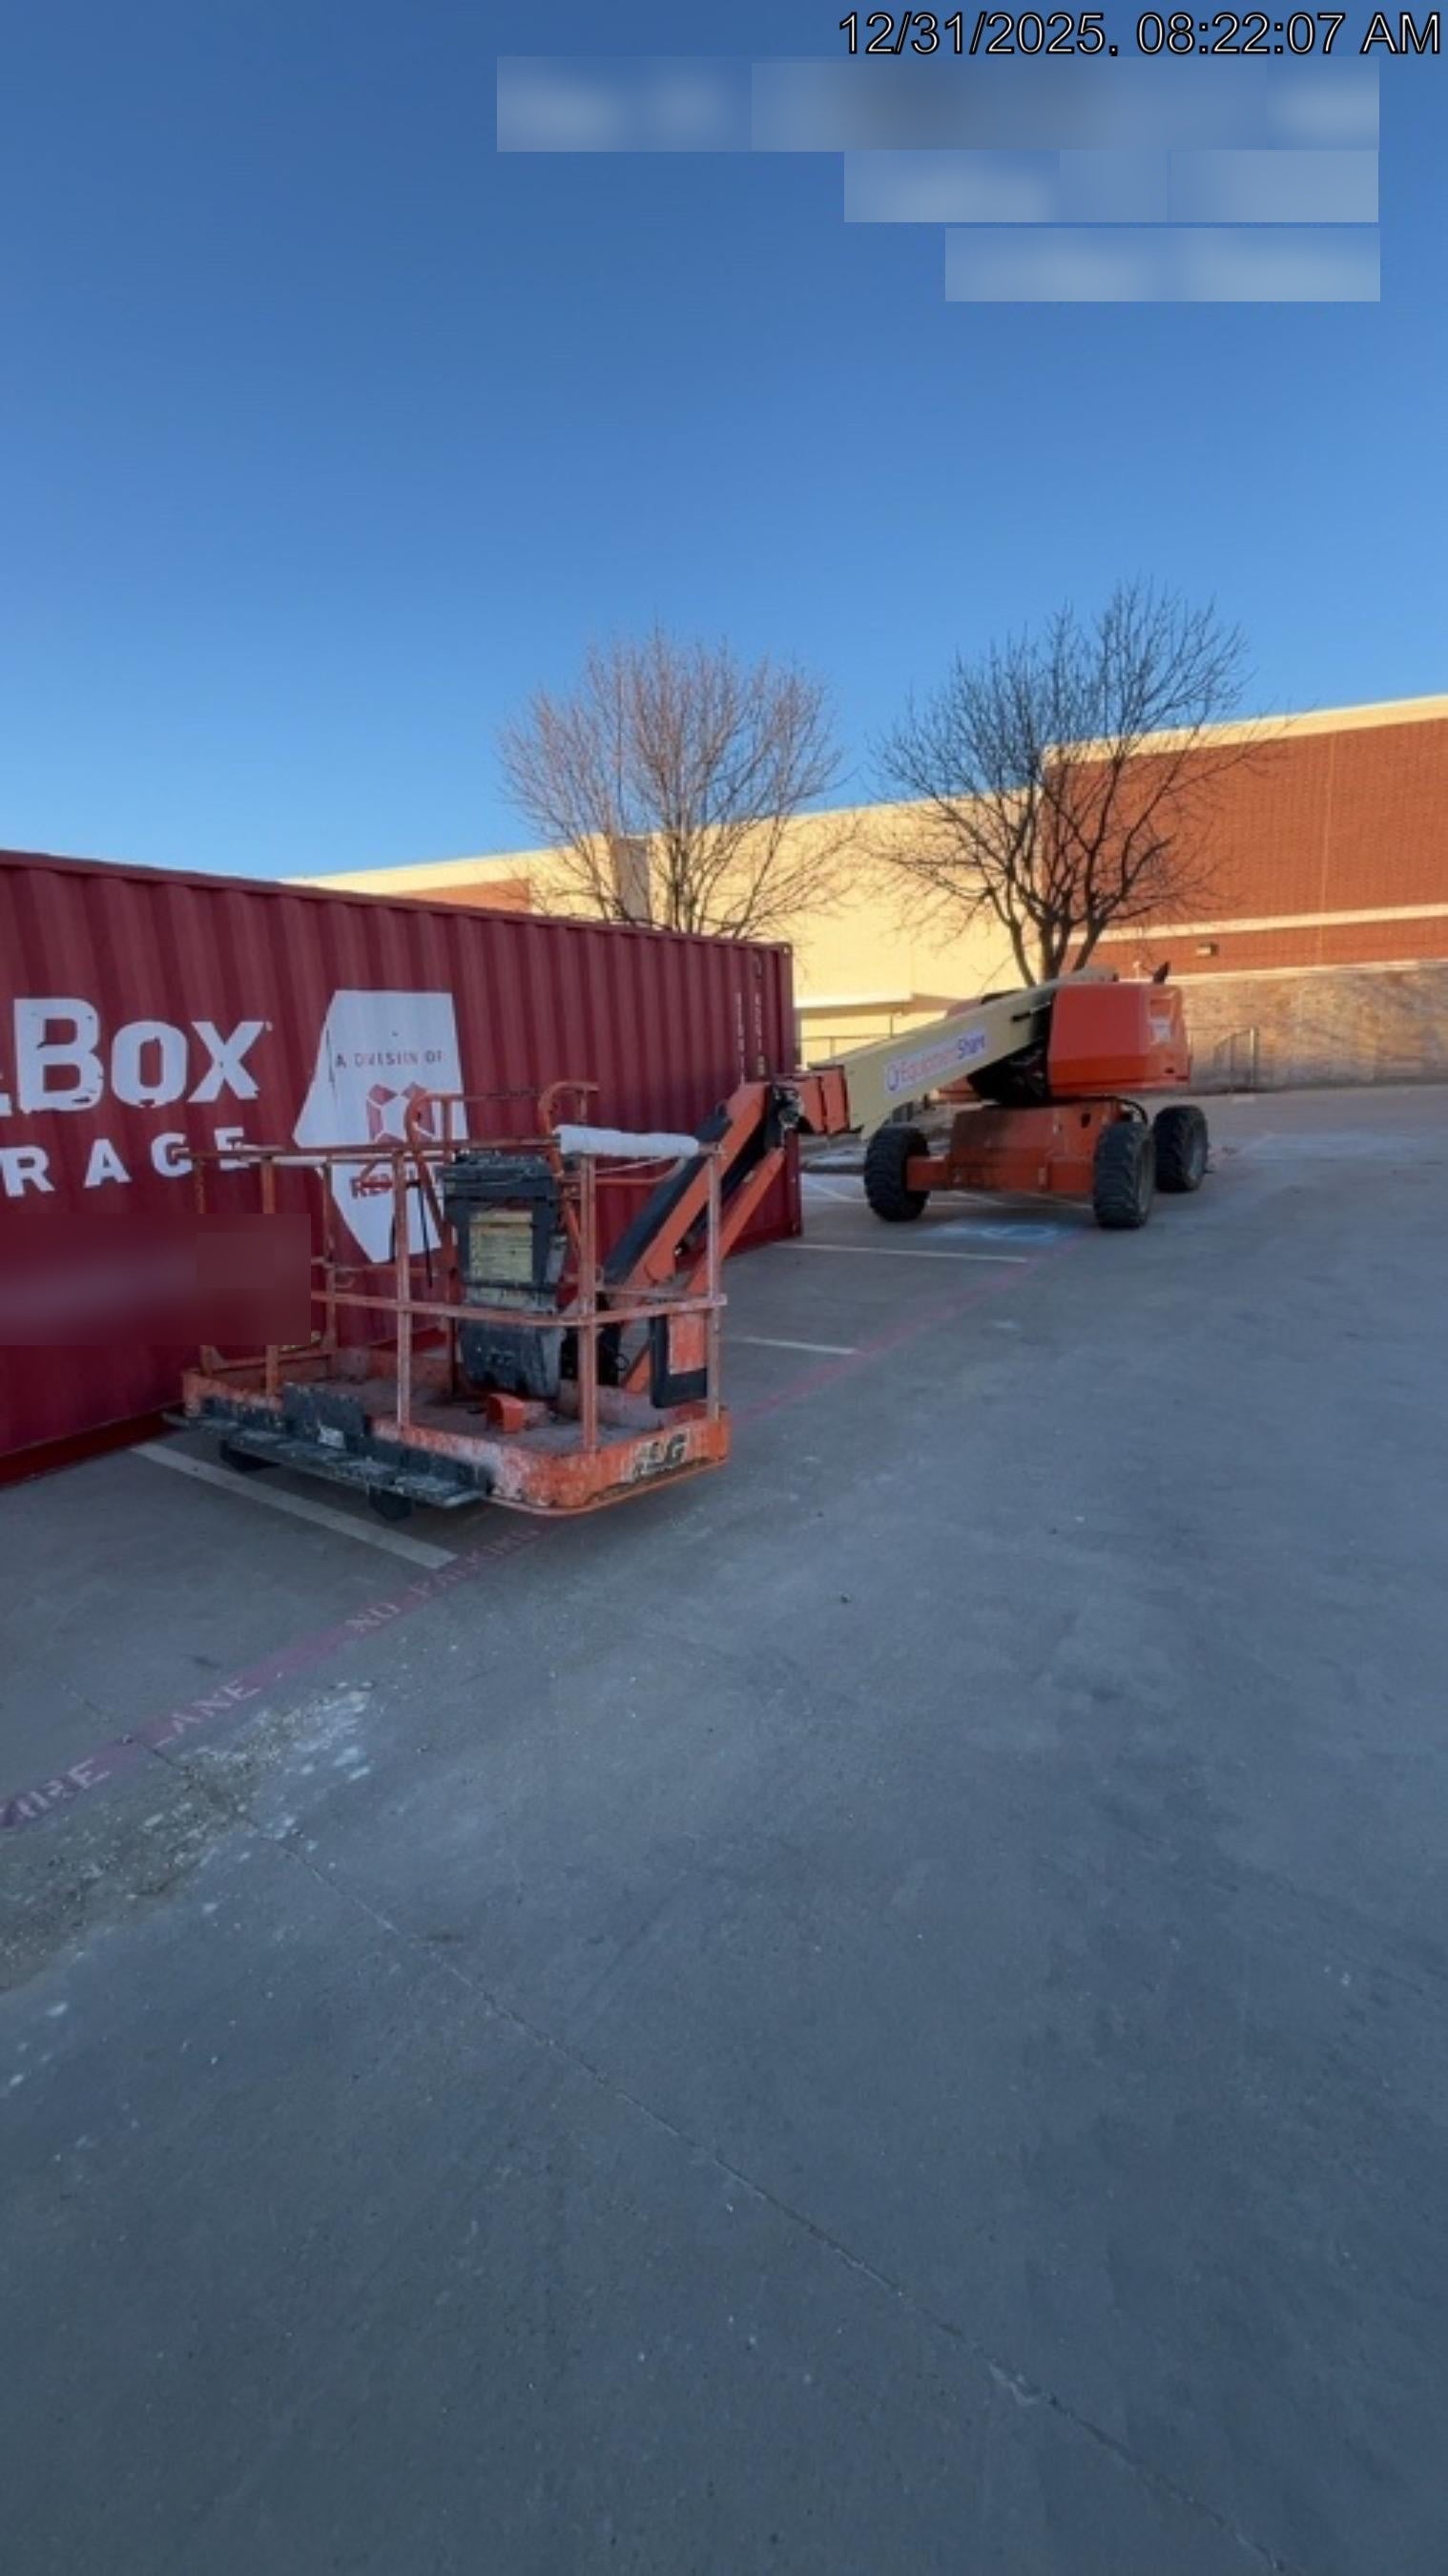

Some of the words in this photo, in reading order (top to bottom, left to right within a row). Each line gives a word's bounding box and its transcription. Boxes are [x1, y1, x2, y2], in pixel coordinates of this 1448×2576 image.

[0, 998, 269, 1114] Box
[335, 1052, 347, 1069] A
[0, 1759, 112, 1824] IRE
